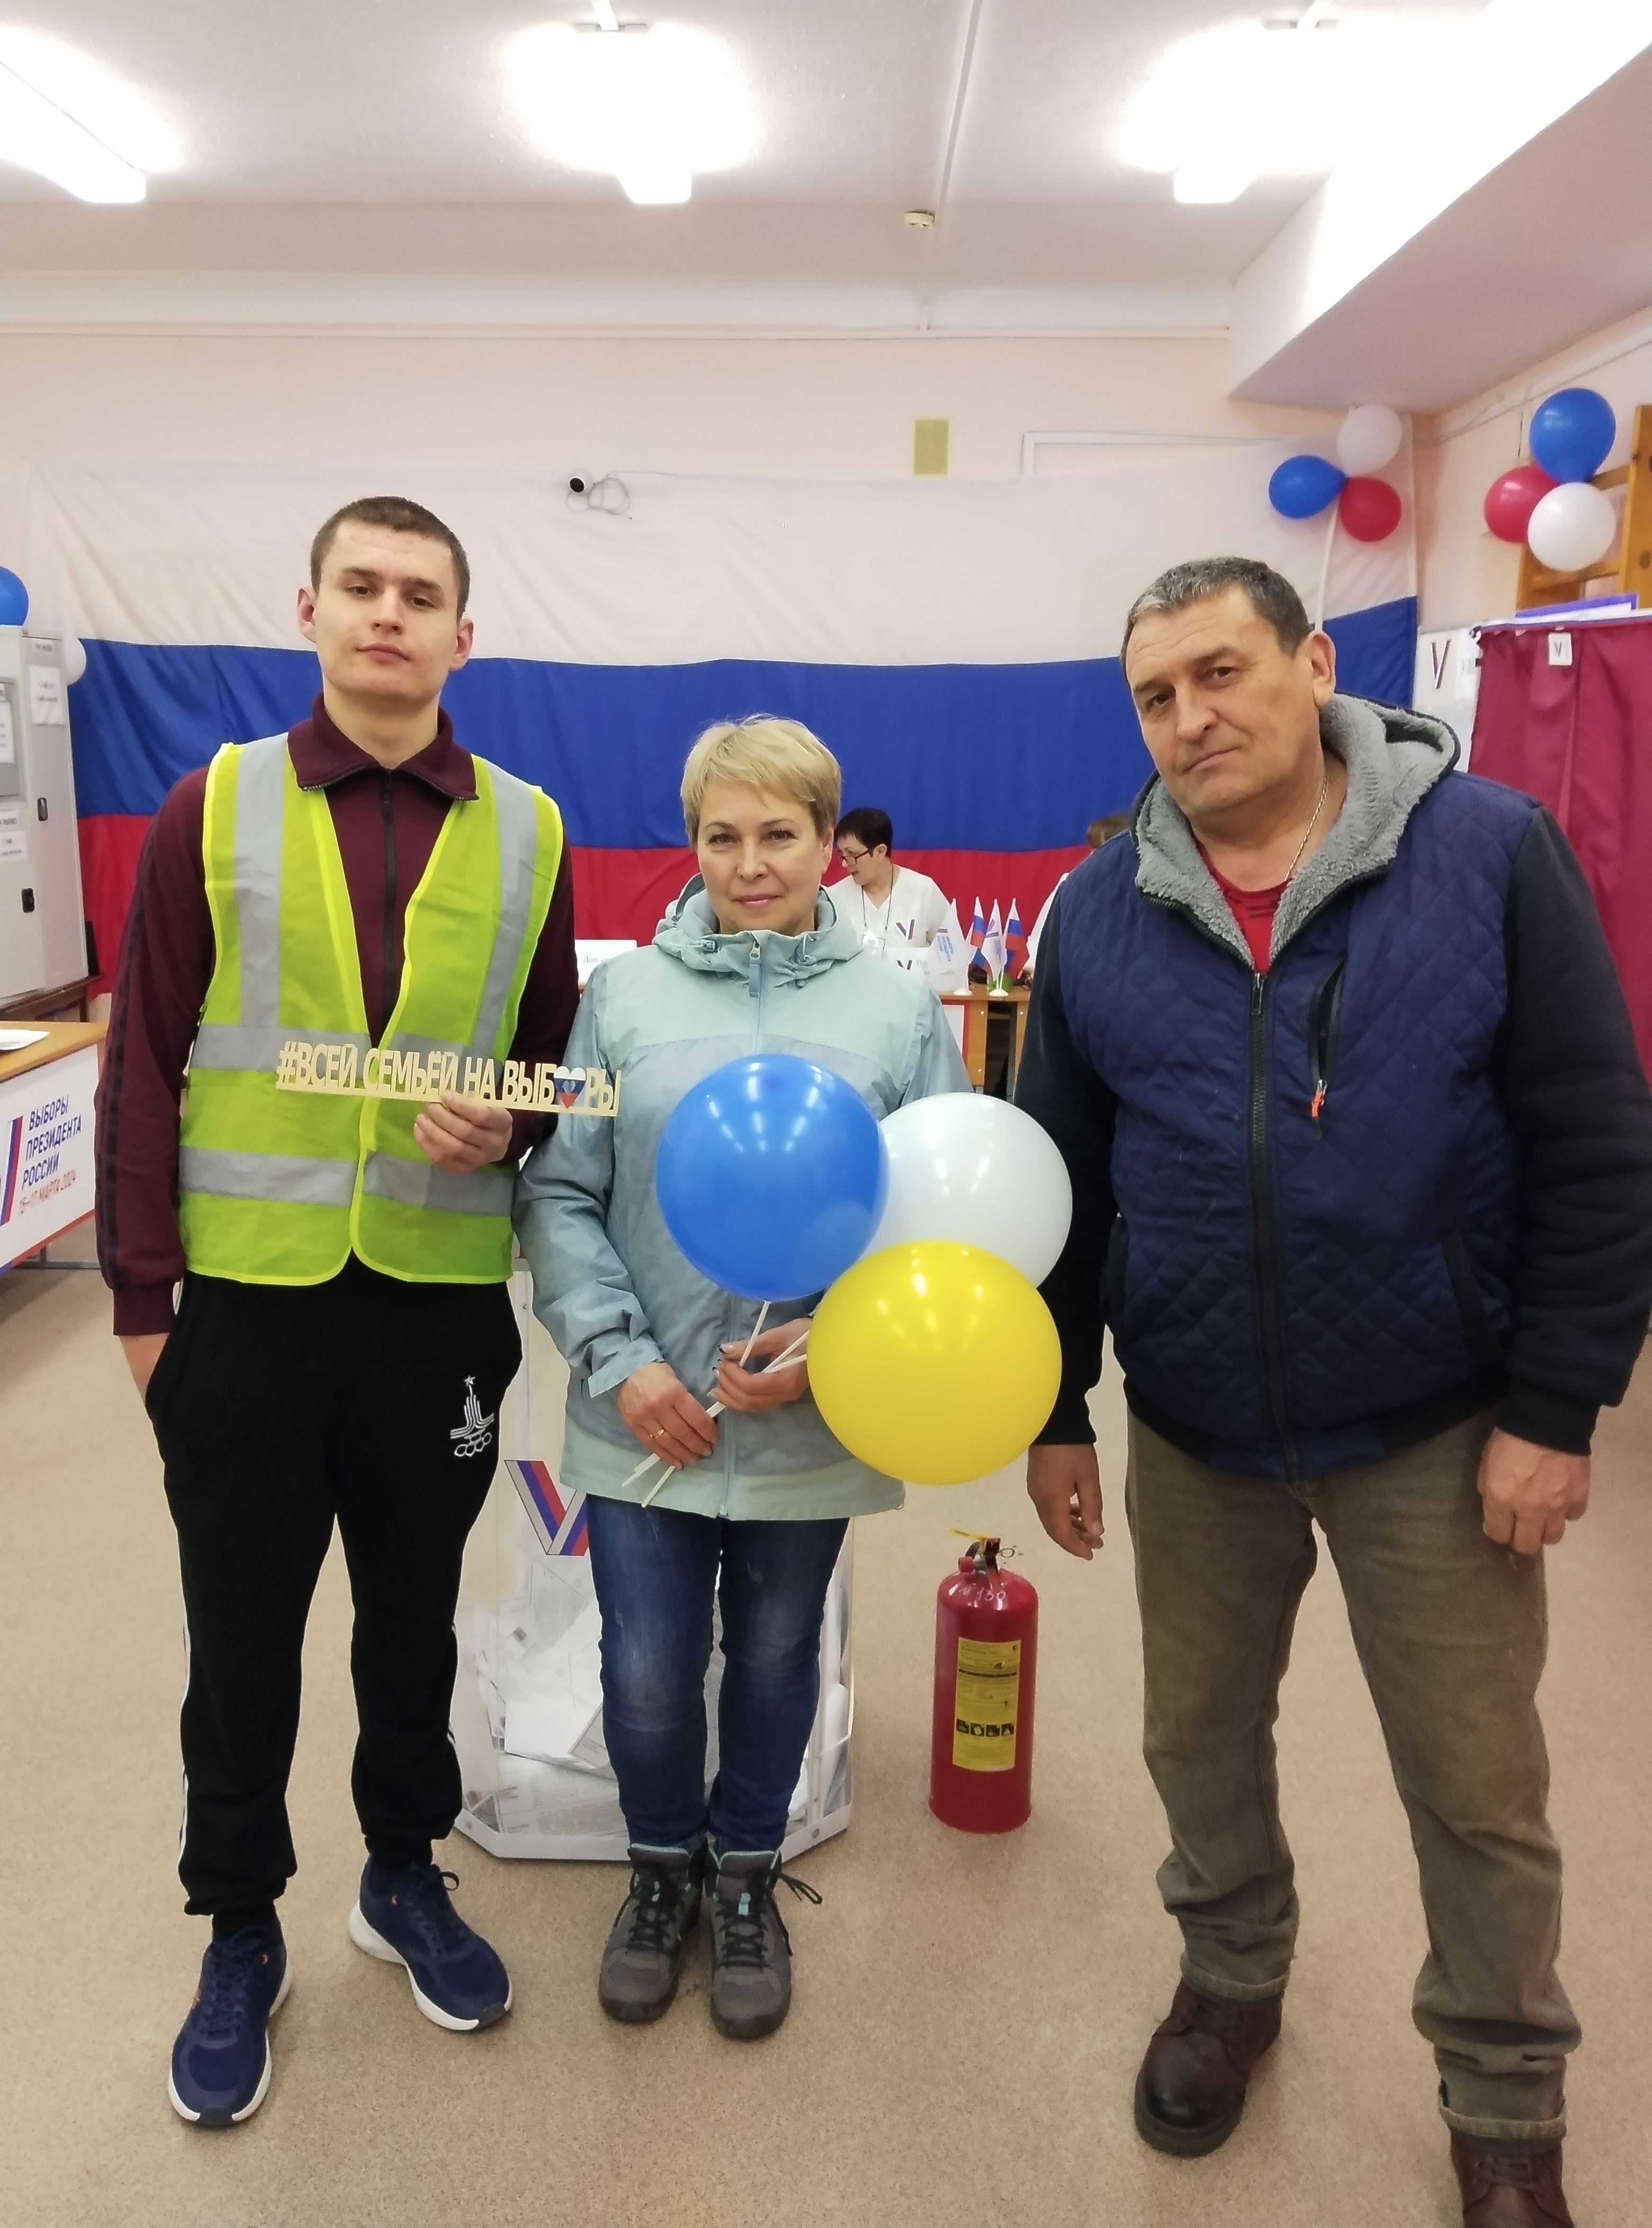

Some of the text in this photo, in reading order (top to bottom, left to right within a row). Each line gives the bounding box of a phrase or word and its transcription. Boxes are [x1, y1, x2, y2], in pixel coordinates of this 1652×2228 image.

[276, 1041, 357, 1089] #ВСЕЙ
[464, 1056, 497, 1101] НА
[29, 1094, 69, 1131] ВЫБОРЫ
[25, 1115, 82, 1161] ПРЕЗИДЕНТА
[22, 1152, 60, 1190] РОССИИ
